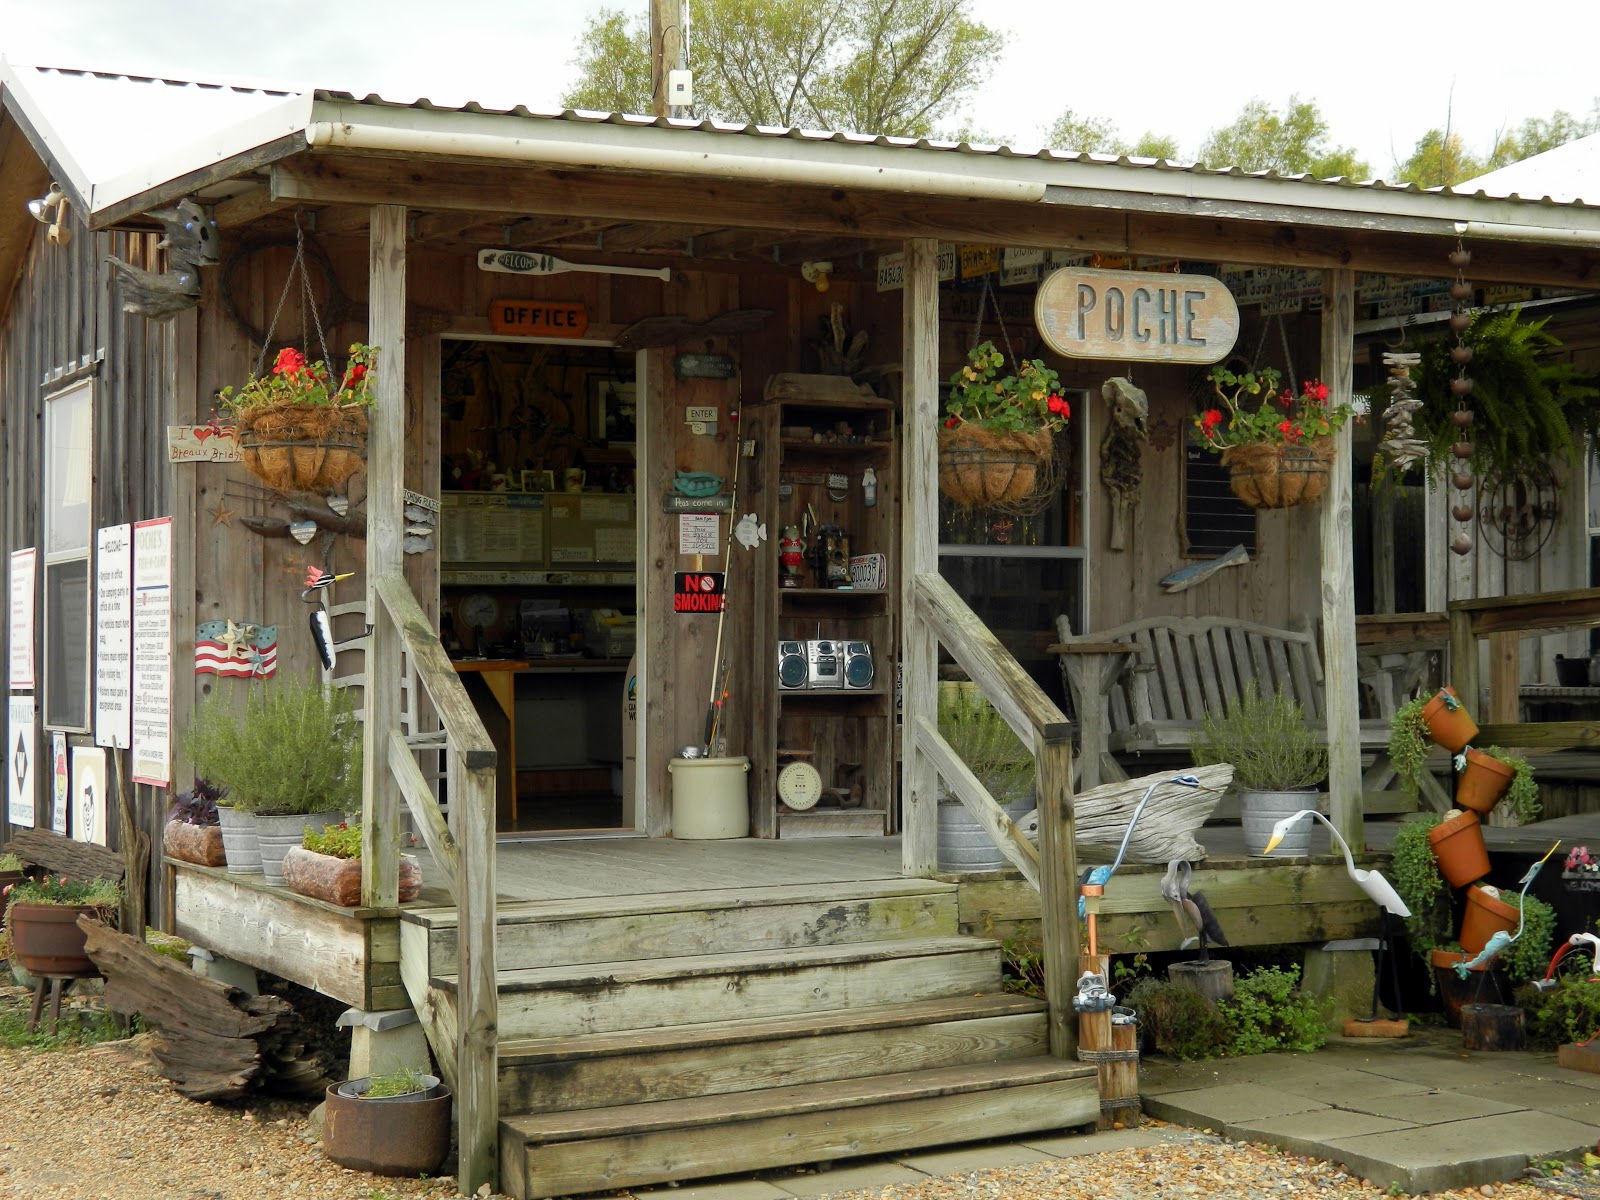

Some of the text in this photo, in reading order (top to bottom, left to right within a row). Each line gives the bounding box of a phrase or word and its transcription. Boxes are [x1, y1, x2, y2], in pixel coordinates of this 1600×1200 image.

[498, 253, 538, 269] WELCOME
[503, 306, 578, 328] OFFICE
[1077, 283, 1207, 347] POCHE
[691, 409, 714, 418] ENTER
[178, 427, 189, 441] I
[171, 446, 208, 461] Breaux
[422, 496, 440, 511] RULES
[674, 497, 690, 508] Peas
[691, 500, 713, 508] come
[674, 593, 727, 611] SMOKIN
